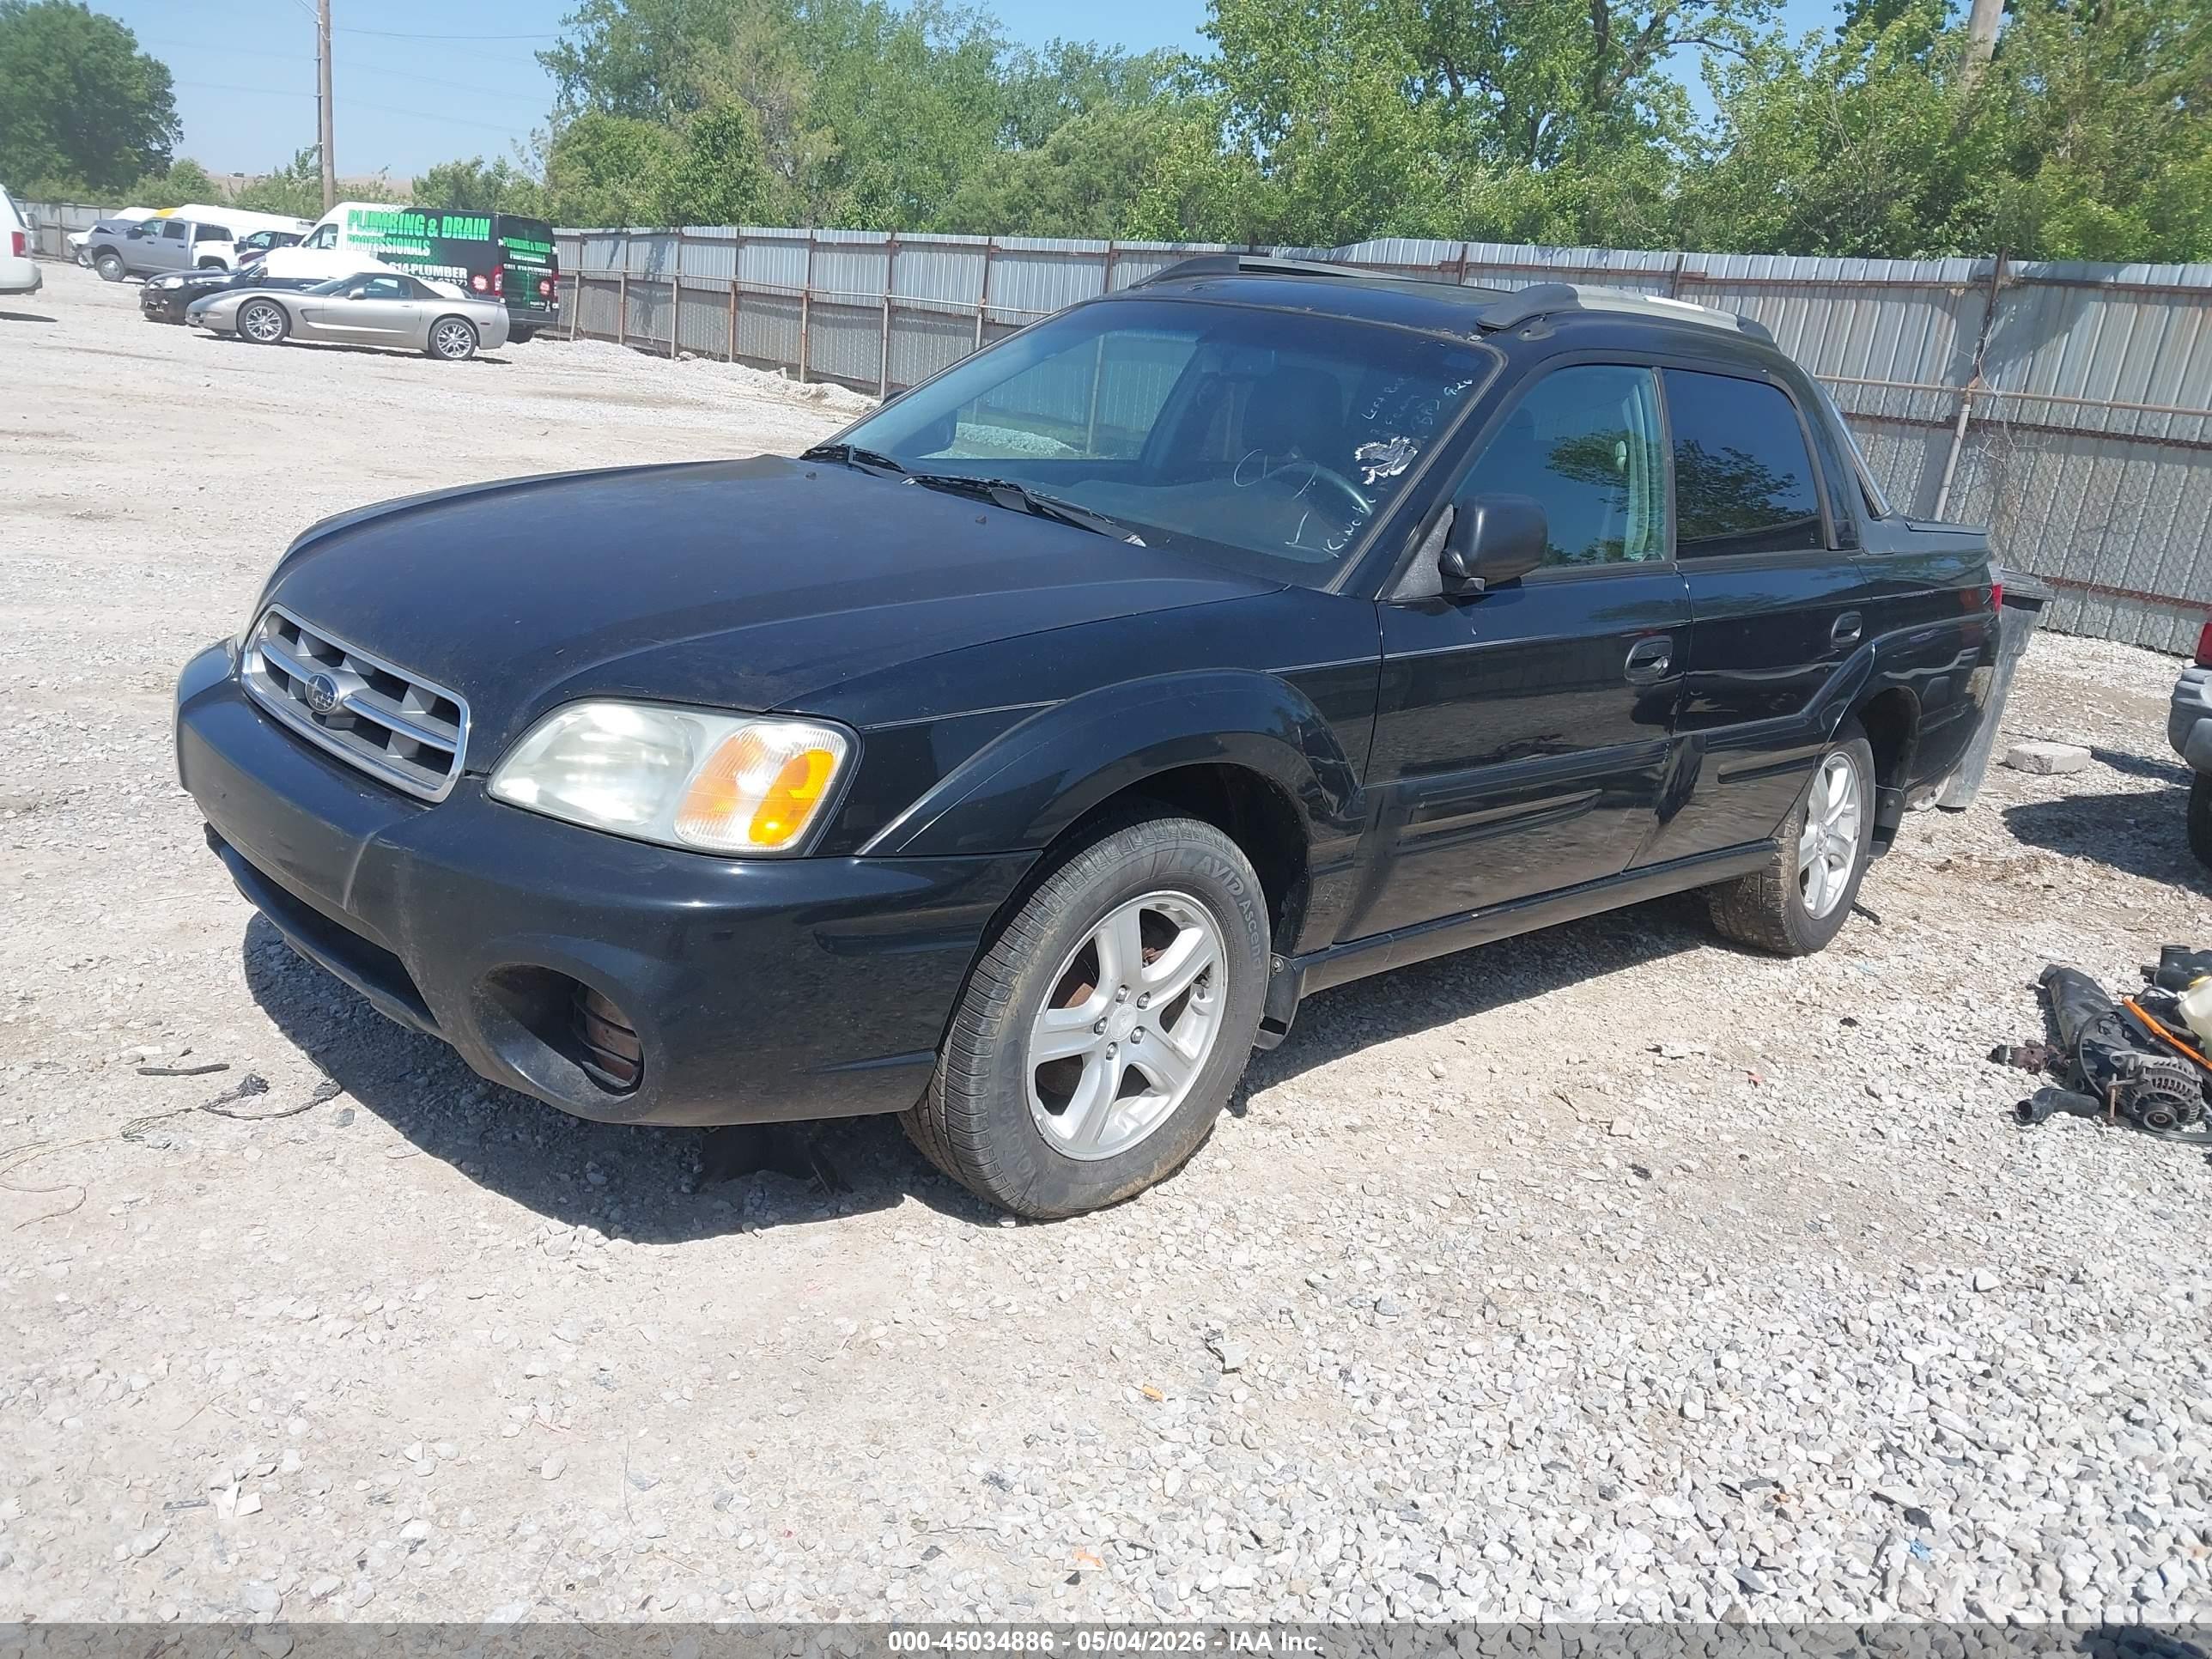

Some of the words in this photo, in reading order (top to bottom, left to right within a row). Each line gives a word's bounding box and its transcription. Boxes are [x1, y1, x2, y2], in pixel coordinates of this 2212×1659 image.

[348, 209, 425, 237] PLUMBING
[427, 218, 439, 238] &
[441, 216, 490, 241] DRAIN
[346, 234, 430, 257] PROFESSIONALS
[1192, 855, 1245, 896] AVID
[1239, 899, 1263, 969] Ascend
